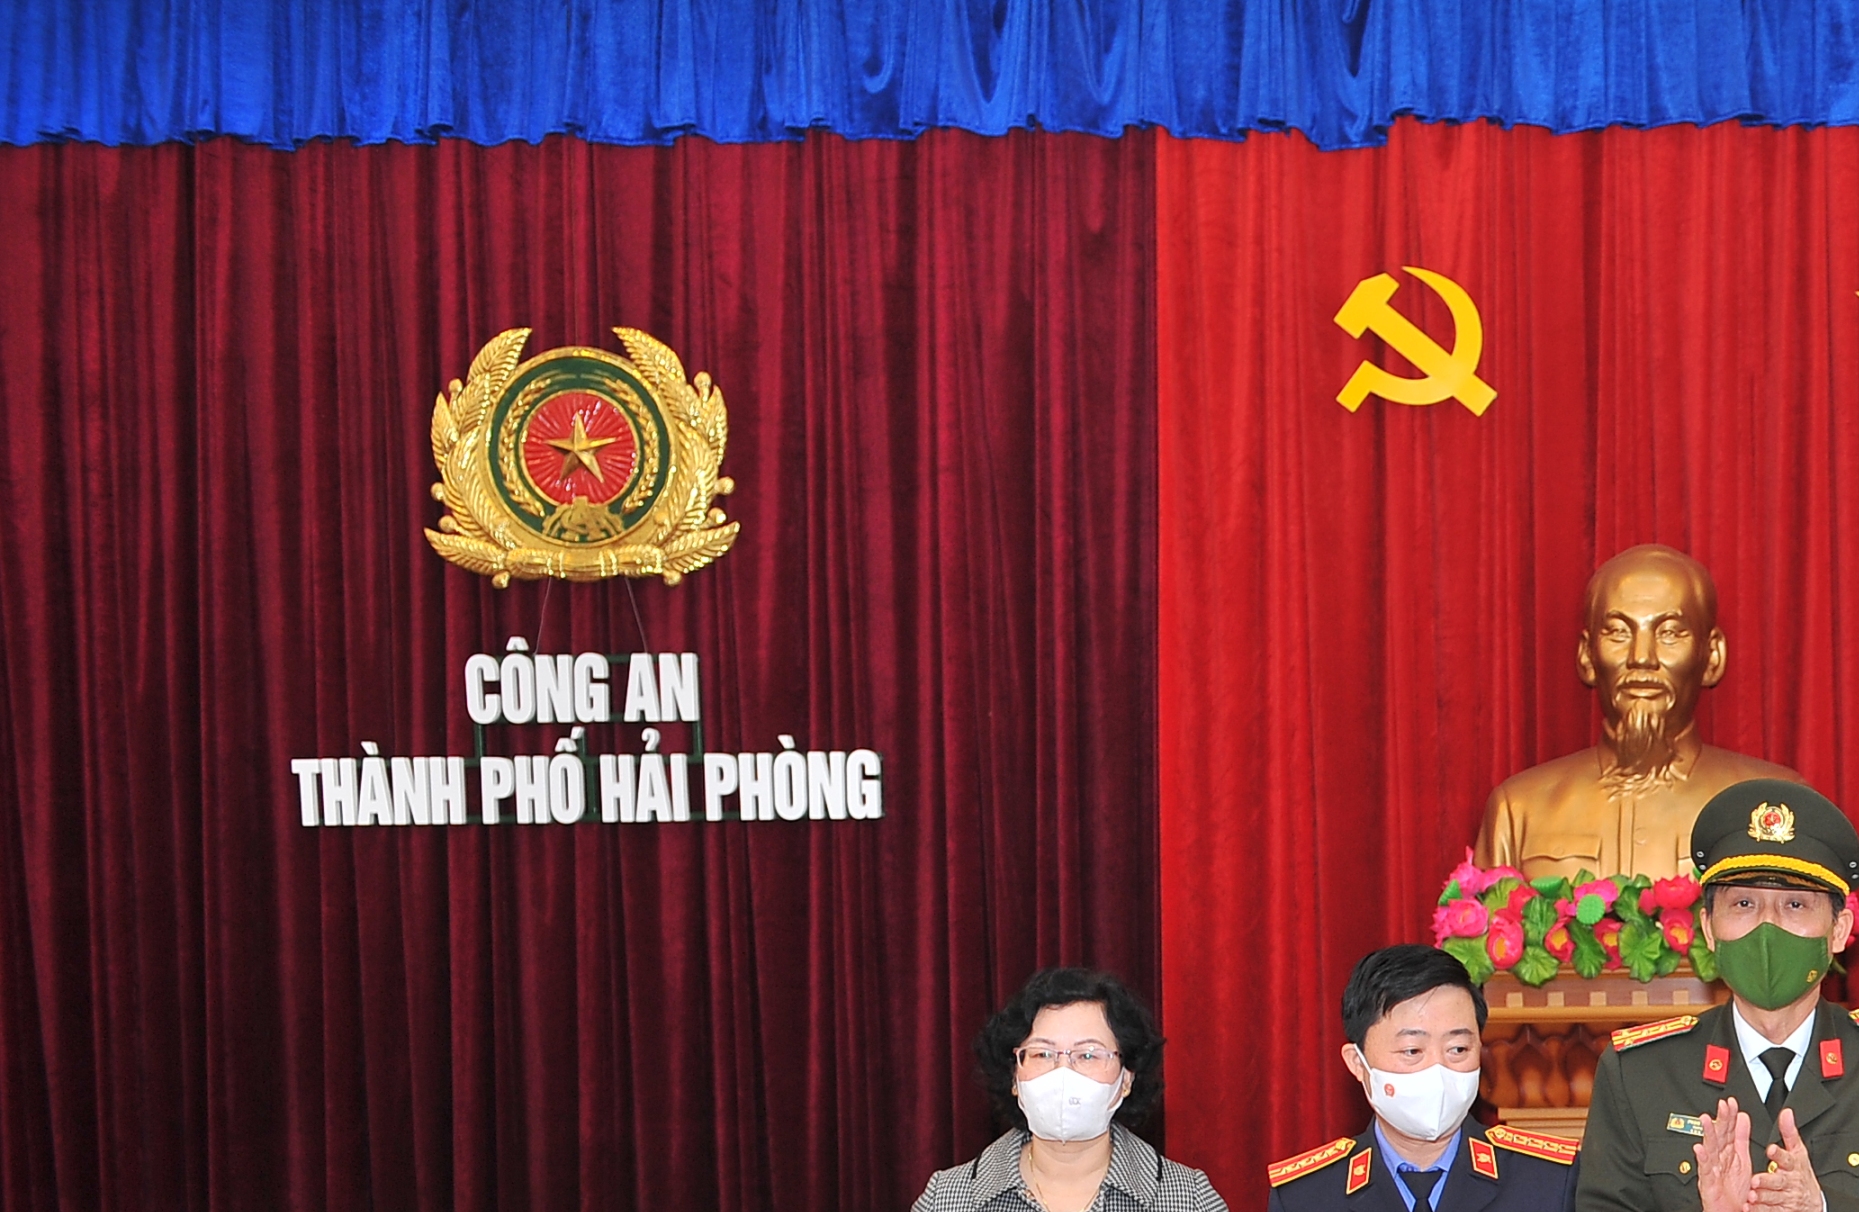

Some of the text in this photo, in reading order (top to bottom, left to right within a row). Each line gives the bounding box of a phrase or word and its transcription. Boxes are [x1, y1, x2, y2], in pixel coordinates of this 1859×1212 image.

[463, 636, 701, 725] CÔNG AN
[290, 726, 883, 828] THÀNH PHỐ HẢI PHÒNG
